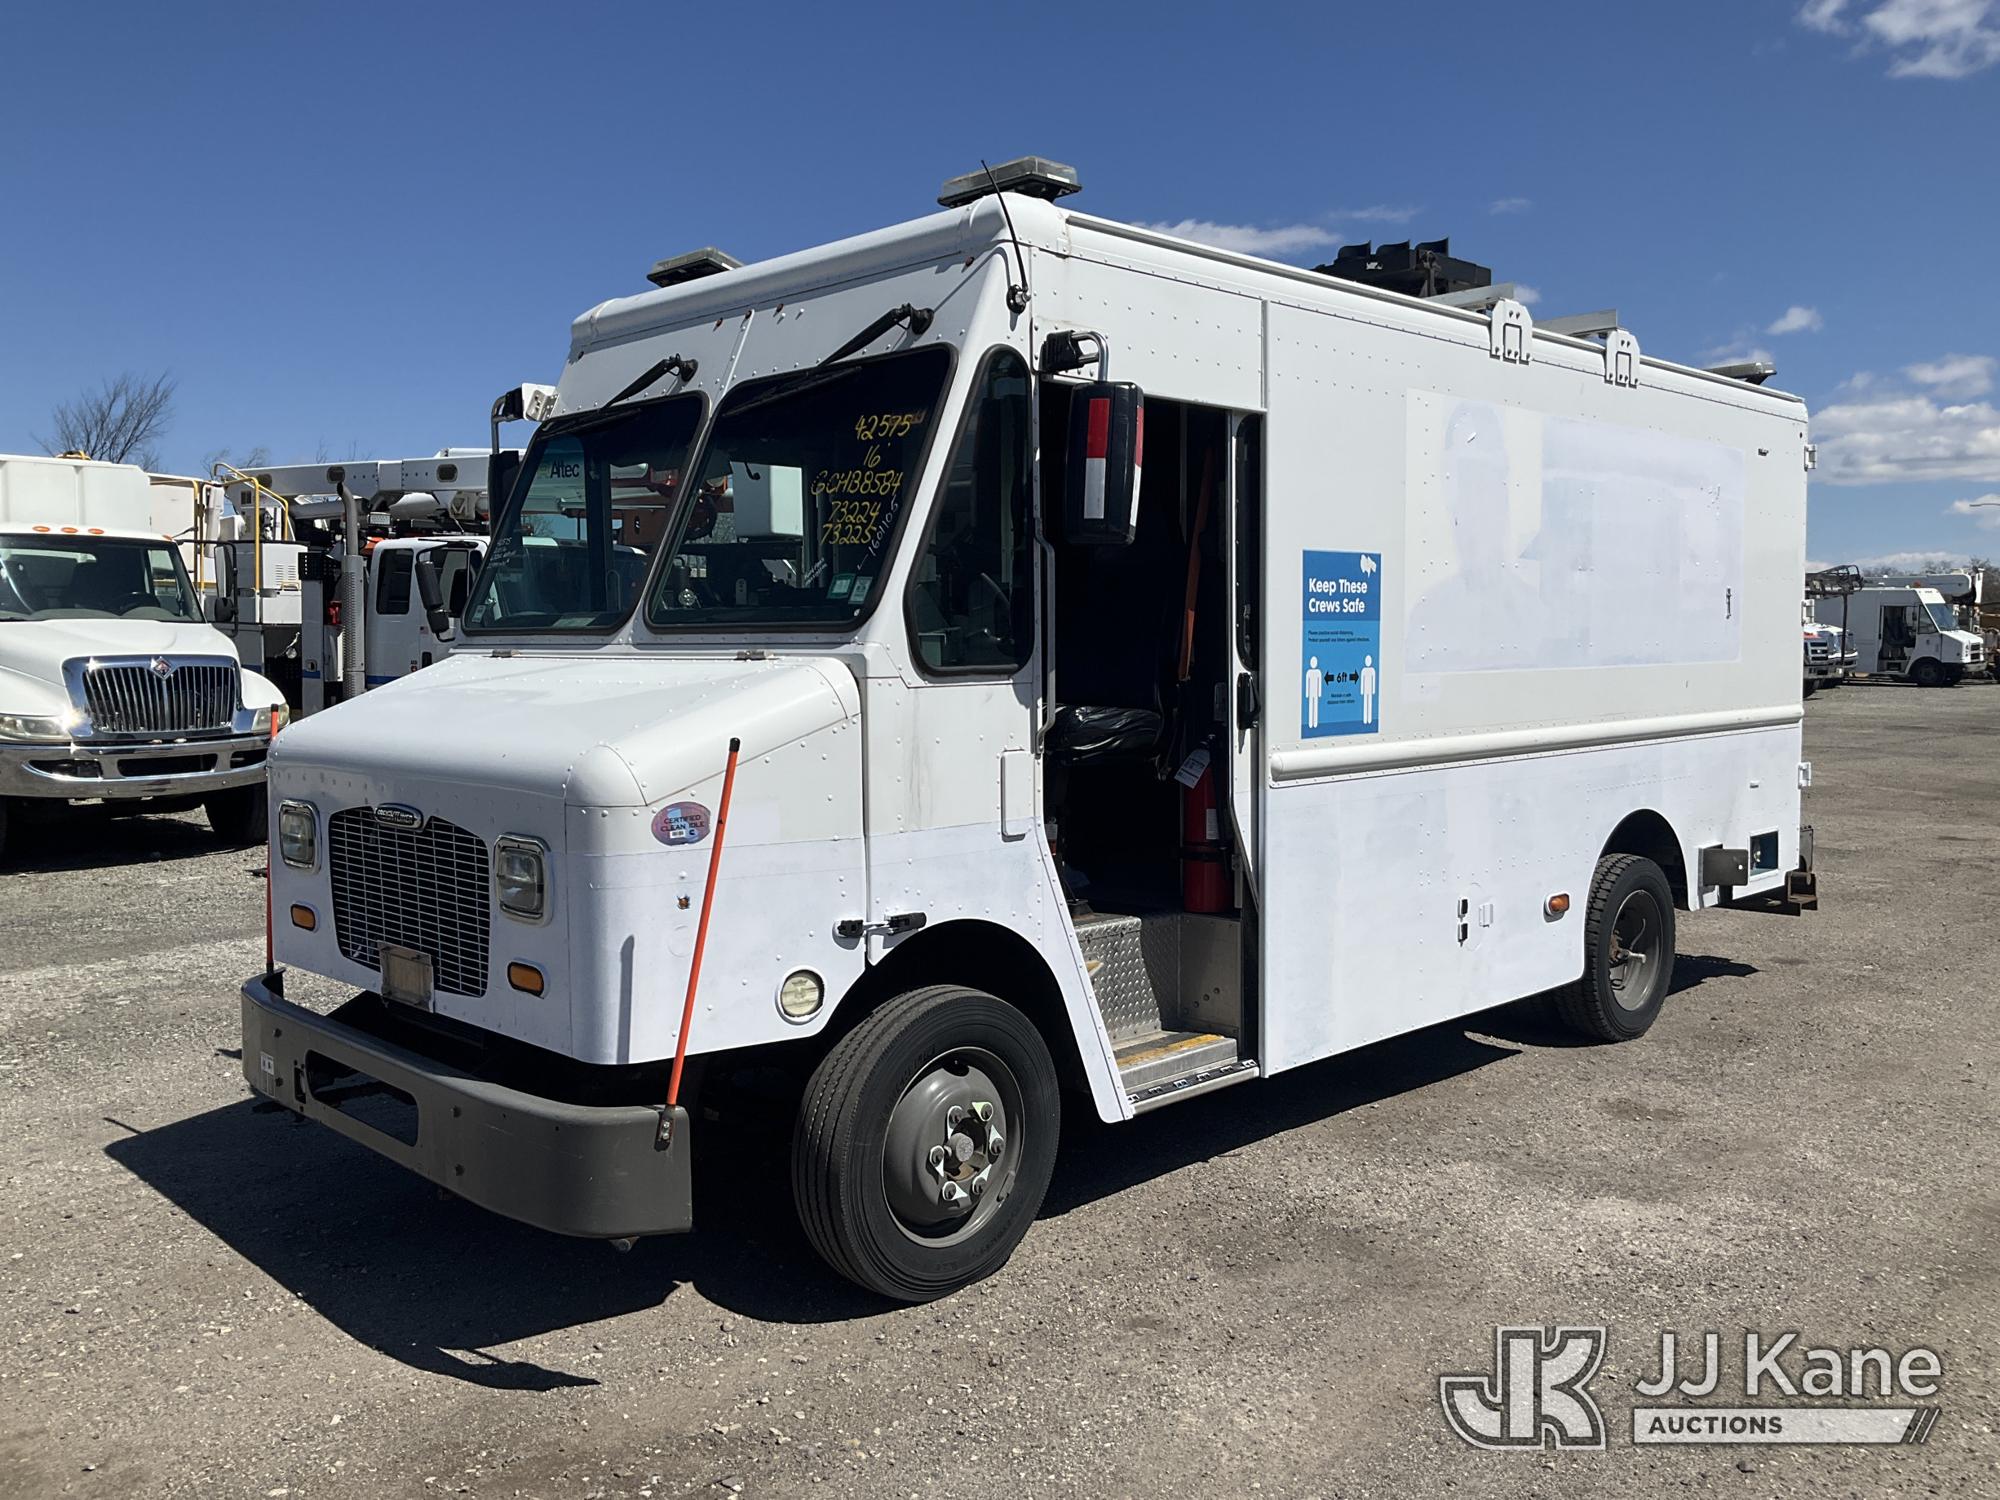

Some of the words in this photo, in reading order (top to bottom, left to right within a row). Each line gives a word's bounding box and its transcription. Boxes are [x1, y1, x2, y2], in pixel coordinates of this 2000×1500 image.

[855, 414, 913, 441] 42575
[863, 444, 881, 468] 16
[550, 459, 580, 478] Altec
[829, 501, 881, 526] 73224
[821, 524, 877, 545] 73225
[1308, 578, 1337, 596] Keep
[1339, 579, 1368, 594] These
[1308, 598, 1341, 613] Crews
[1342, 598, 1366, 613] Safe
[1336, 672, 1348, 683] 6ft
[660, 823, 686, 832] CLEAN
[664, 814, 701, 824] CERTIFIED
